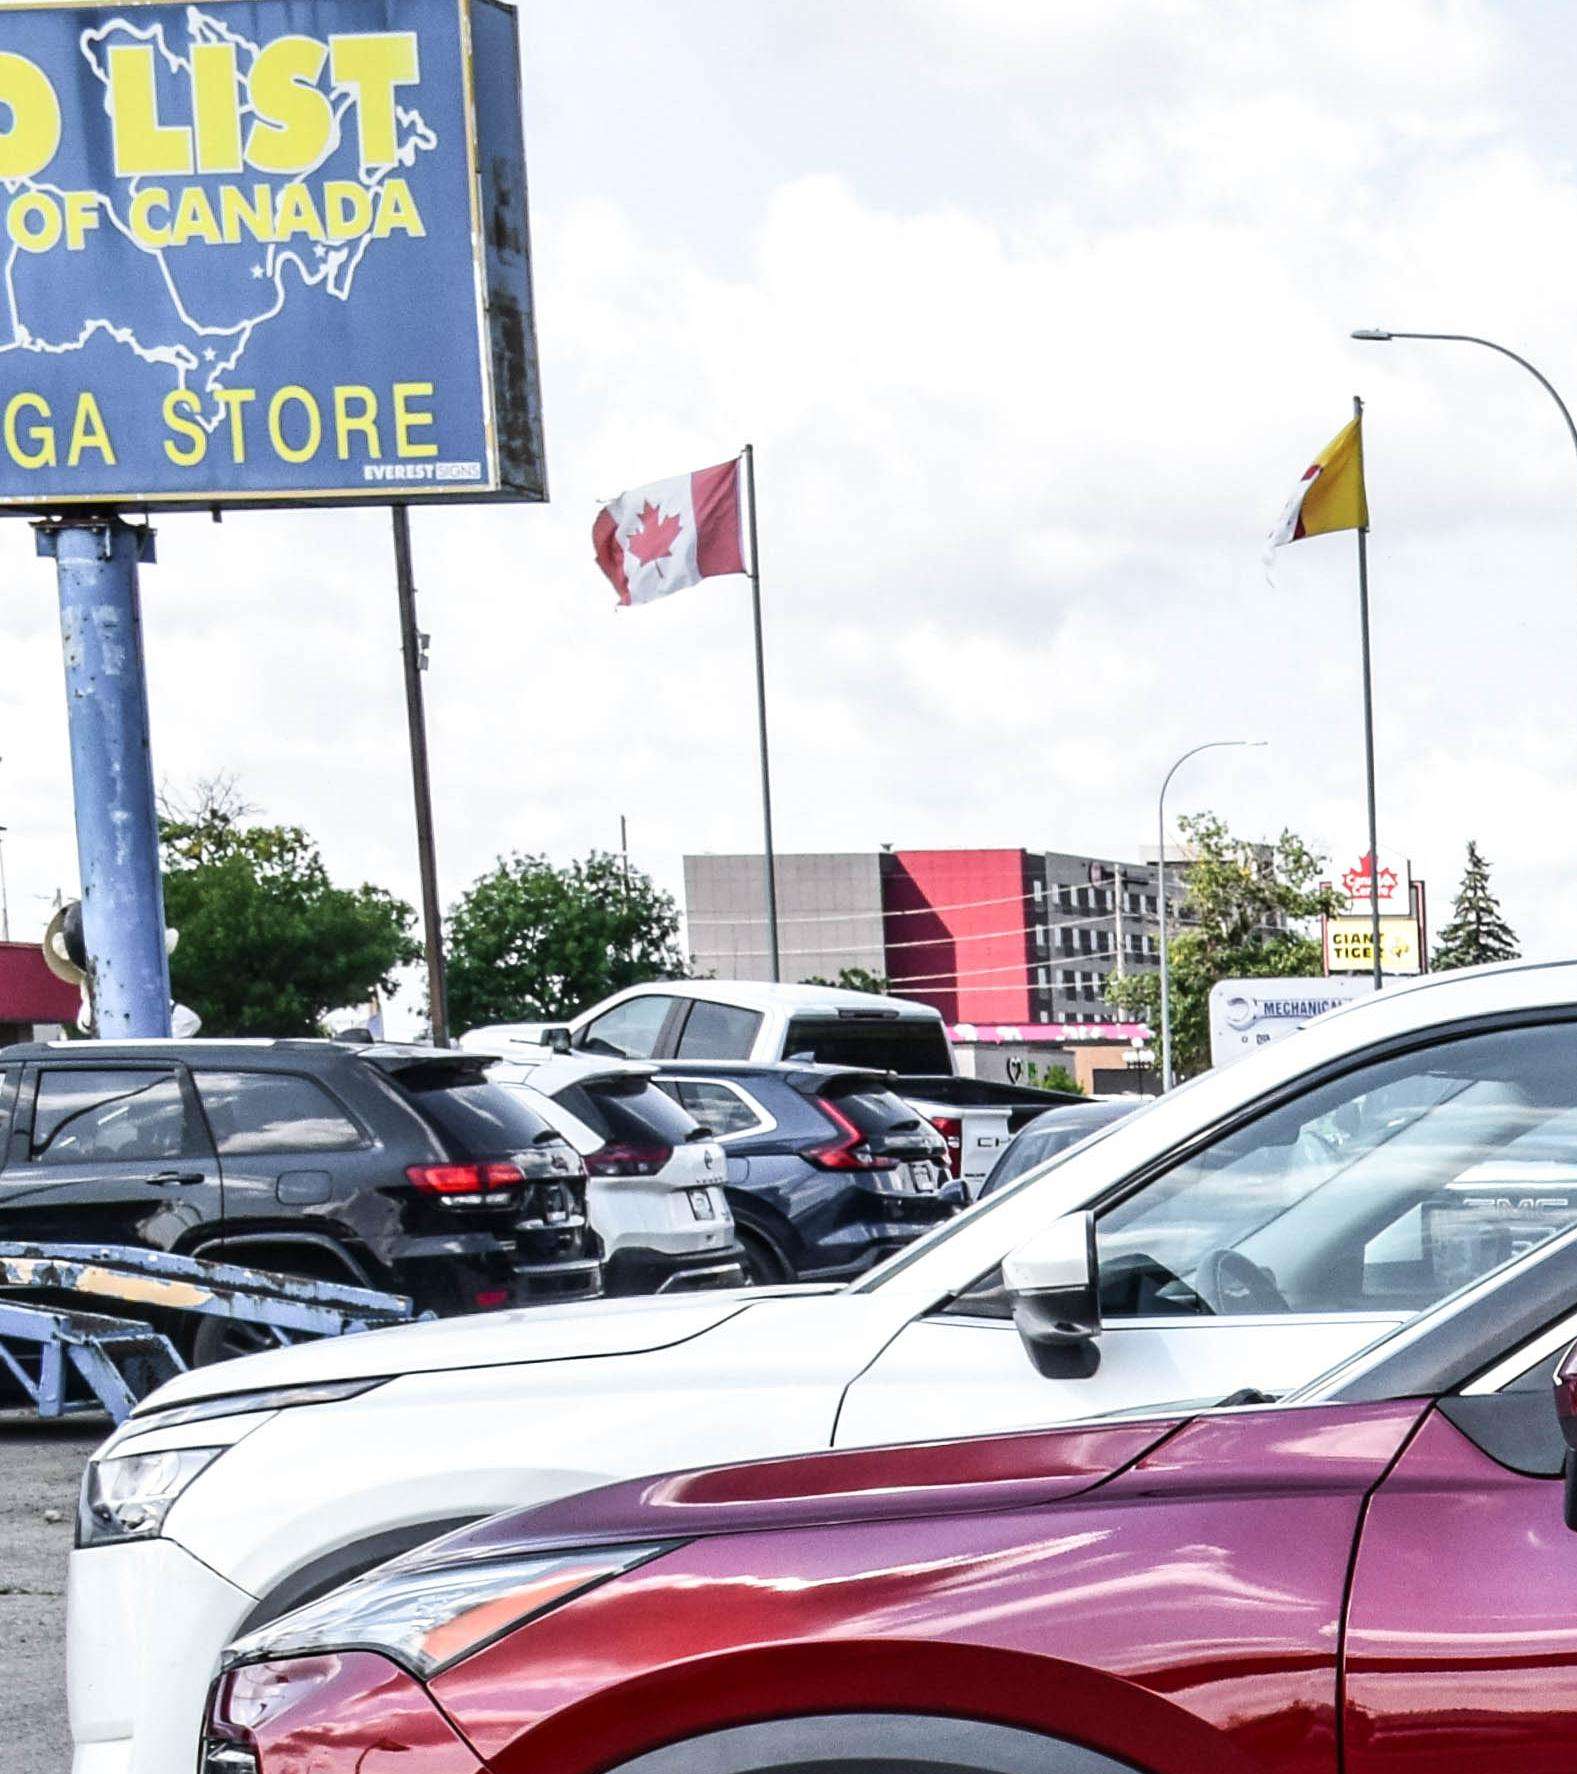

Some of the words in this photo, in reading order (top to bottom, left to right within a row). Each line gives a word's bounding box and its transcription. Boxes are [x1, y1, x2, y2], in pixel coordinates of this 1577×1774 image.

[107, 32, 419, 178] LIST
[7, 191, 99, 252] OF
[129, 178, 426, 251] CANADA
[4, 391, 117, 469] GA
[162, 381, 439, 464] STORE
[364, 464, 434, 480] EVEREST
